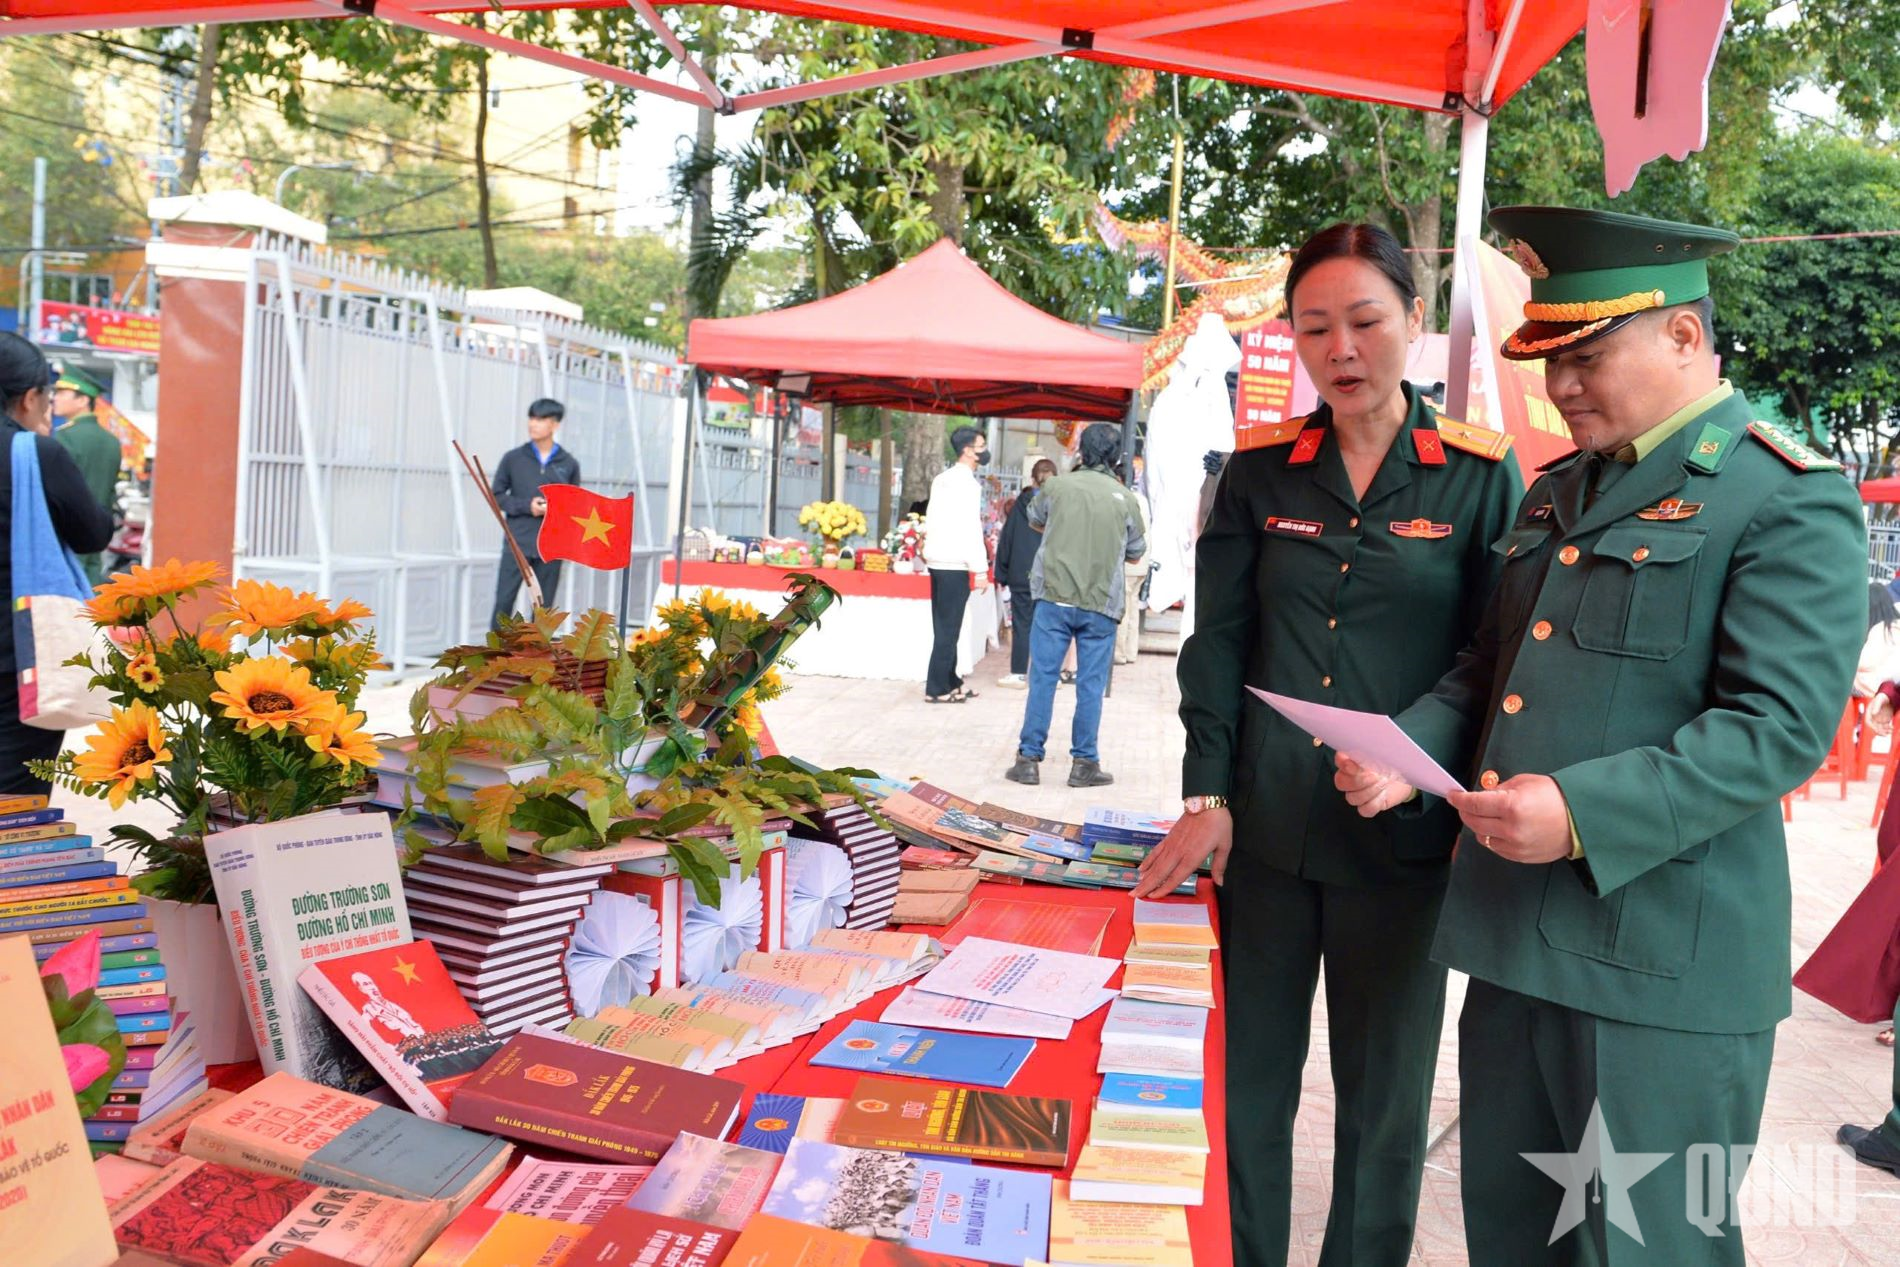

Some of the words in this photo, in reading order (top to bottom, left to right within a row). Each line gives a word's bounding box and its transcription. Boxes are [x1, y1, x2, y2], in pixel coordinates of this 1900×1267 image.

[241, 889, 257, 918] ĐƯỜNG
[290, 887, 328, 915] ĐƯỜNG
[328, 881, 369, 909] TRƯỜNG
[369, 881, 391, 901] SƠN
[295, 913, 334, 940] ĐƯỜNG
[333, 909, 350, 933] HỒ
[349, 907, 368, 930] CHÍ
[368, 905, 395, 926] MINH
[249, 919, 264, 953] TRƯỜNG
[254, 954, 268, 972] SƠN
[259, 978, 276, 1008] ĐƯỜNG
[266, 1008, 280, 1021] HỒ
[268, 1022, 282, 1038] CHÍ
[272, 1039, 286, 1062] MINH
[32, 1090, 55, 1113] DÂN
[222, 1107, 257, 1128] KHU
[44, 1140, 70, 1162] QUỐC
[551, 1170, 573, 1193] MINH
[972, 1178, 990, 1198] THẮNG
[911, 1218, 928, 1239] QUÂN
[924, 1170, 942, 1184] DÂN
[944, 1194, 962, 1208] NAM
[970, 1197, 986, 1210] TẤT
[966, 1210, 985, 1228] QUÂN
[691, 1231, 722, 1256] NAM
[964, 1228, 982, 1245] ĐOÀN
